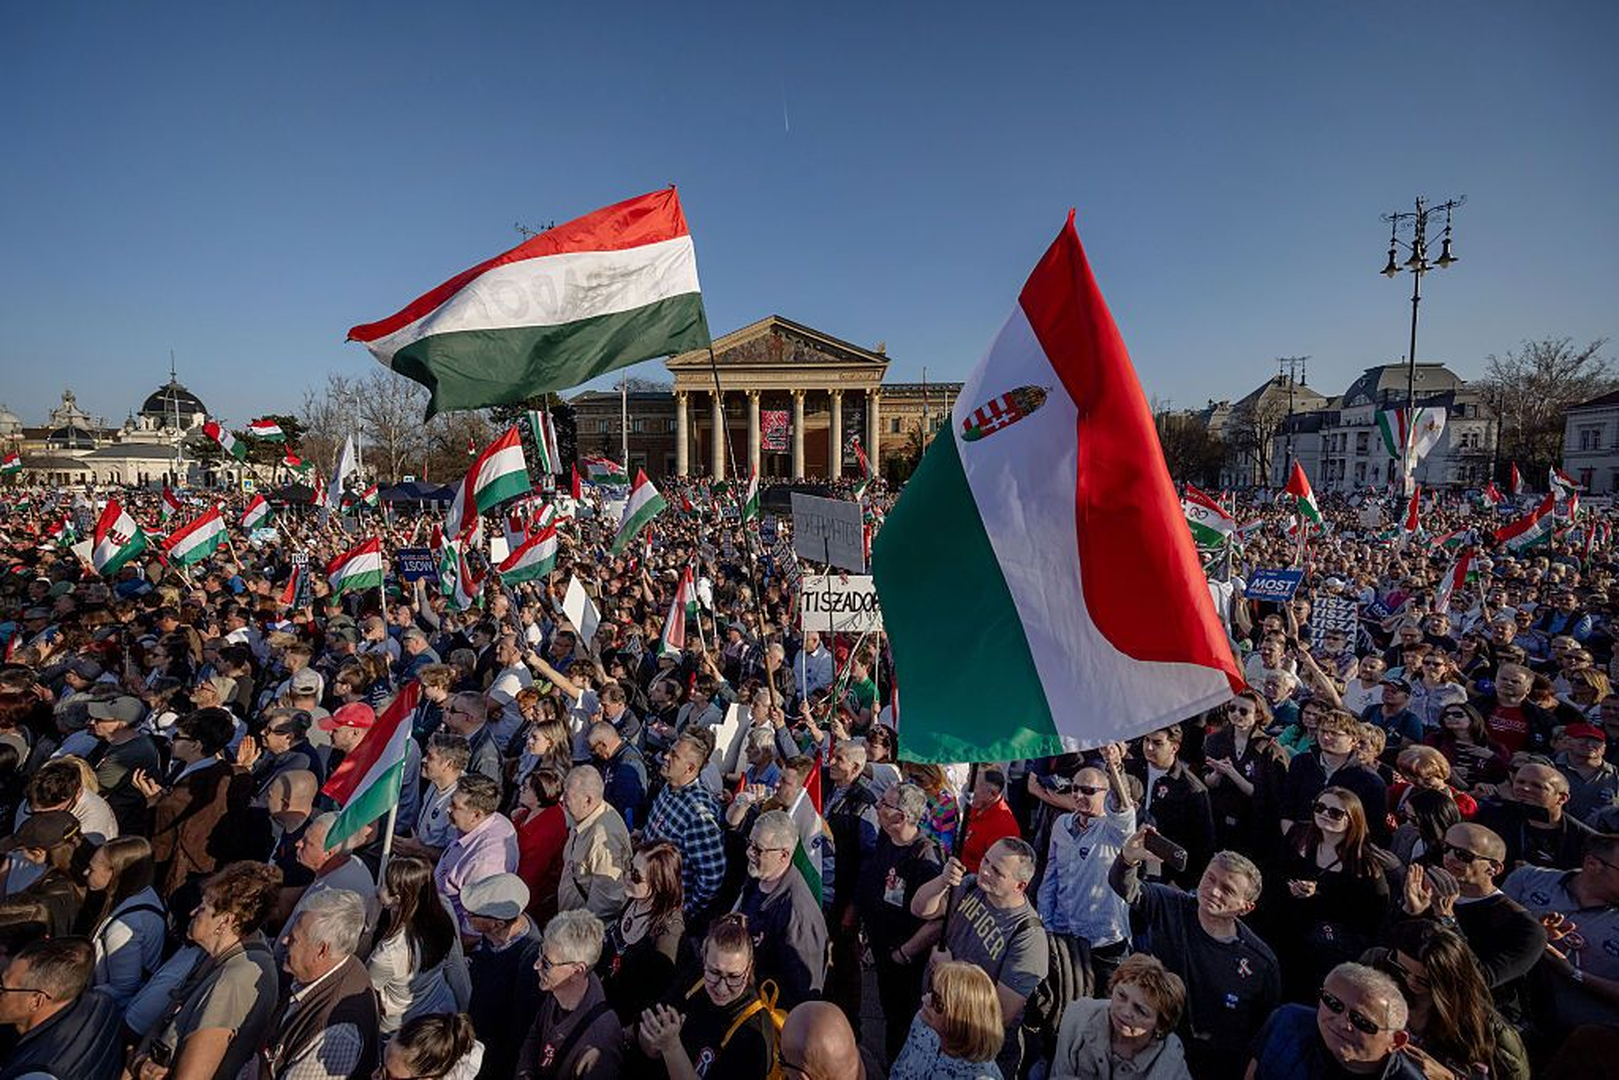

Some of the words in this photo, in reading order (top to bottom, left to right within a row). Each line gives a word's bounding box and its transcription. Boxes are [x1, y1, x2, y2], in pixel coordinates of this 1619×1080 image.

[404, 561, 433, 572] MOST
[1251, 578, 1296, 591] MOST
[1313, 598, 1357, 611] TISZA
[1313, 608, 1357, 621] TISZA
[1312, 618, 1356, 632] TISZA
[1311, 628, 1355, 643] TIA
[1310, 639, 1355, 653] TIA
